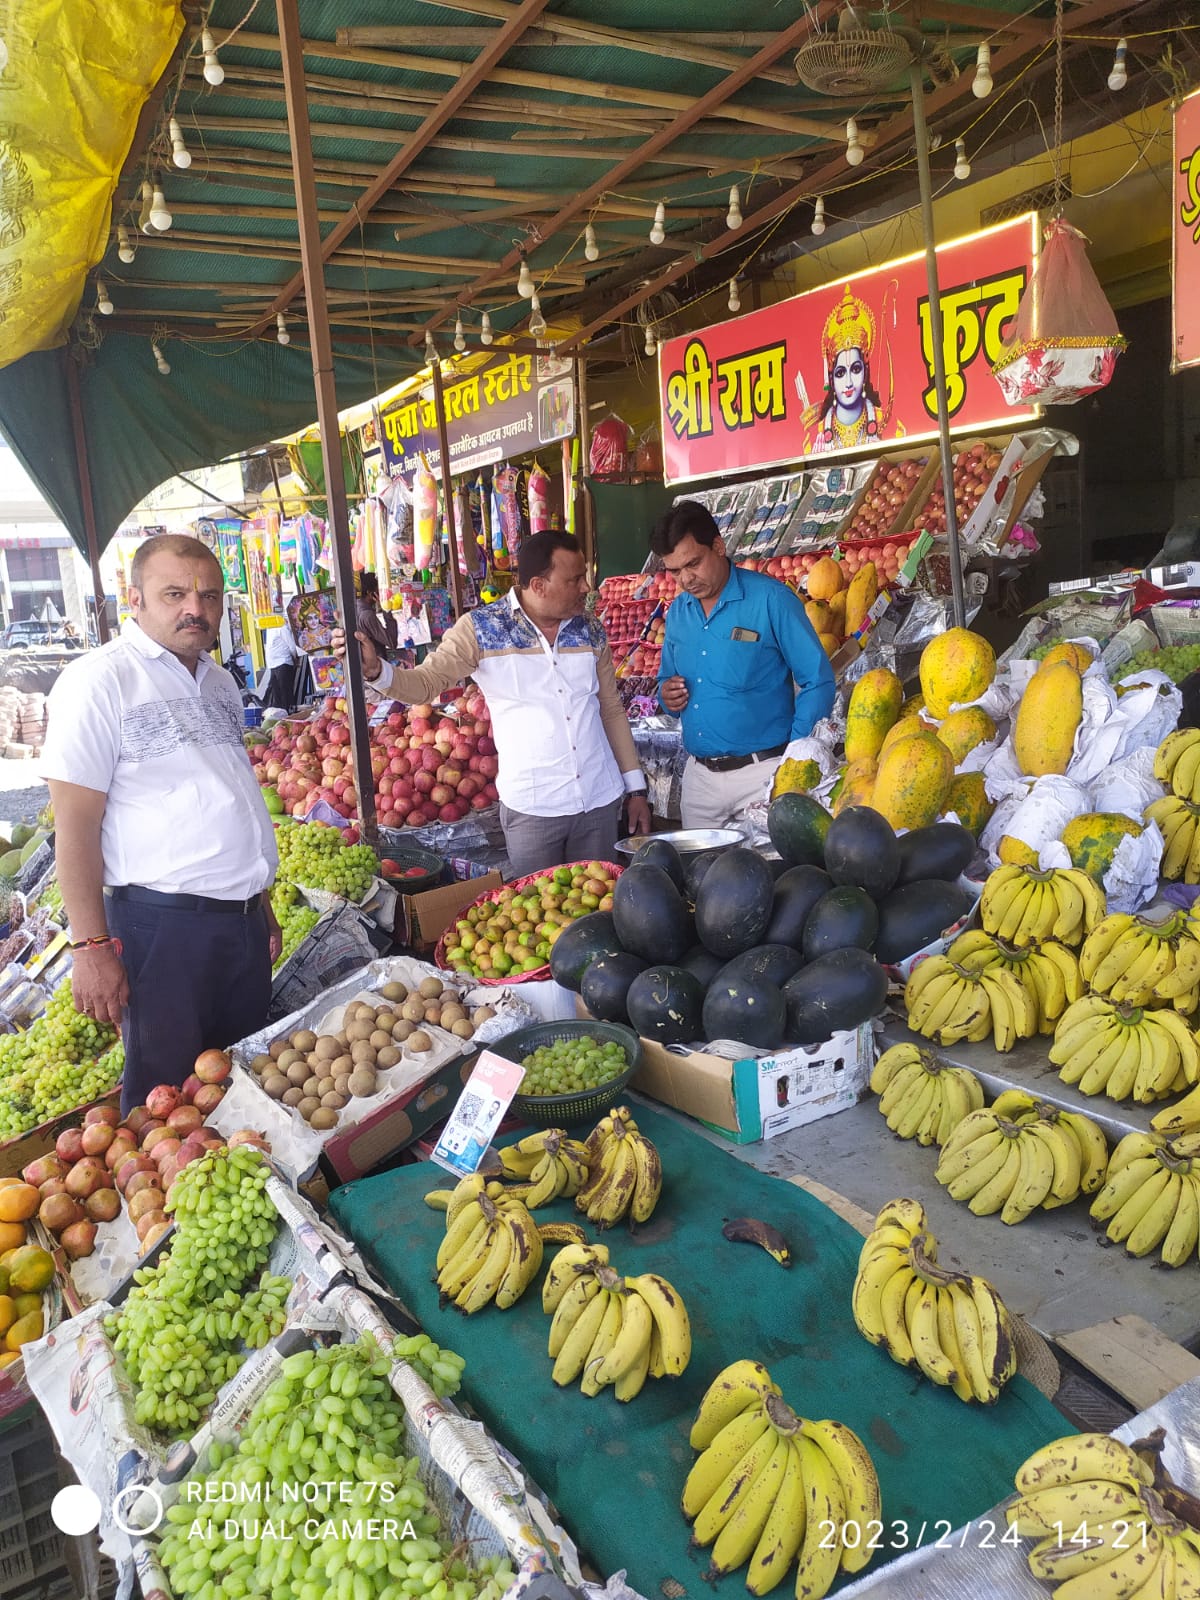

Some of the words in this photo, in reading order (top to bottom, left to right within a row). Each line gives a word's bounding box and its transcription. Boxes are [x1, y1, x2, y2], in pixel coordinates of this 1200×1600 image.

[383, 402, 419, 456] पूजा
[420, 375, 480, 429] जरल
[483, 352, 532, 406] स्टोर
[526, 411, 534, 433] है
[666, 338, 712, 440] श्री
[717, 340, 786, 432] राम
